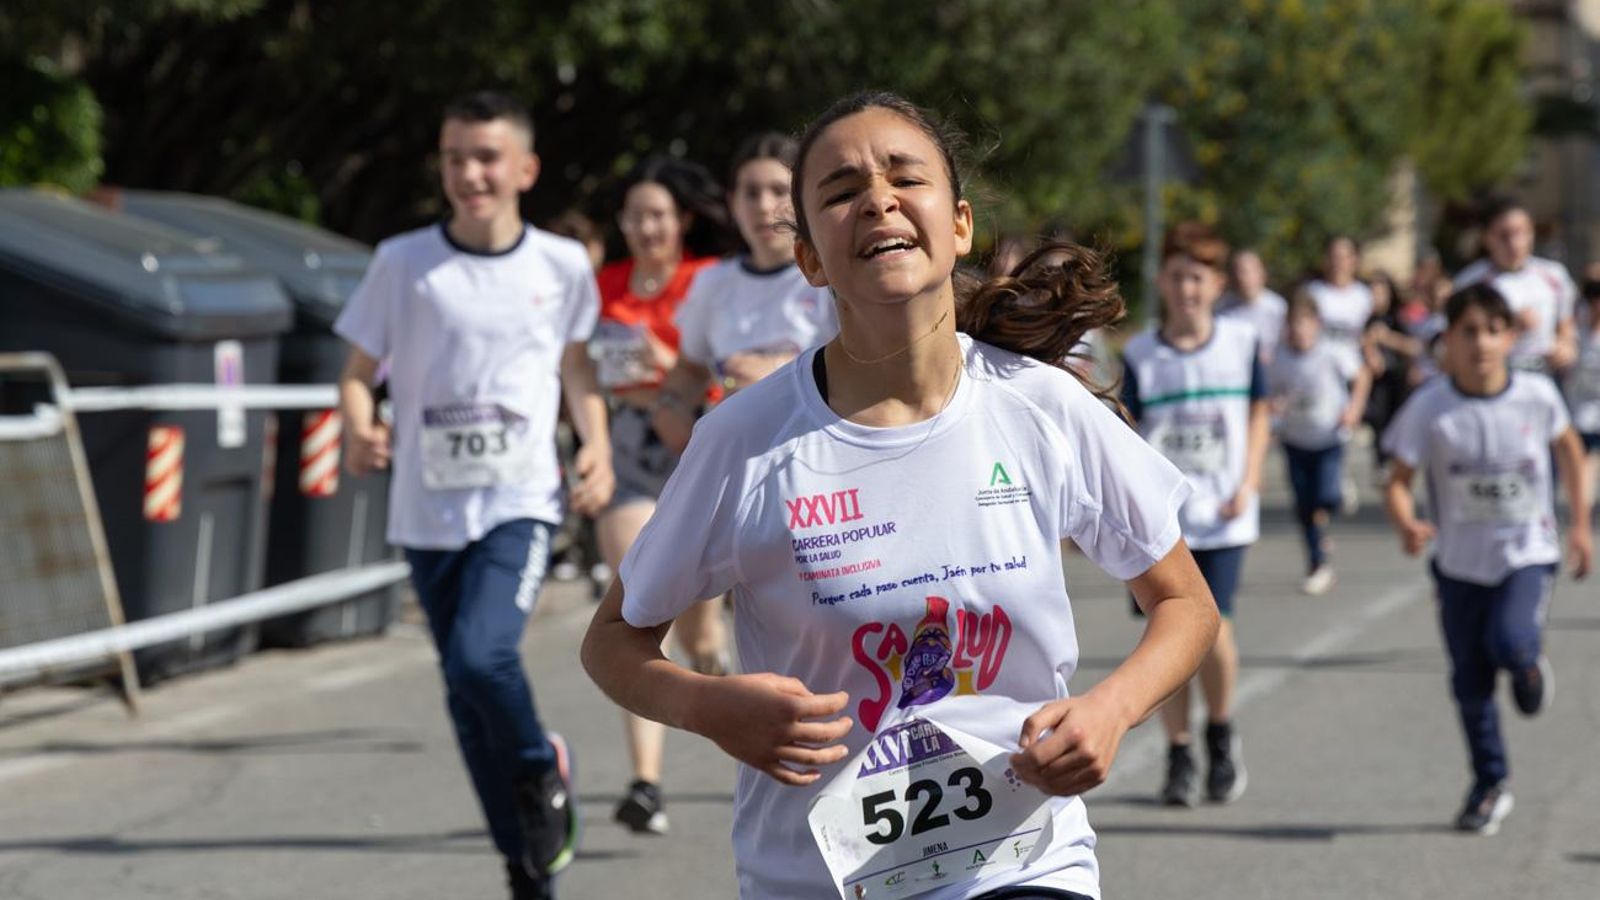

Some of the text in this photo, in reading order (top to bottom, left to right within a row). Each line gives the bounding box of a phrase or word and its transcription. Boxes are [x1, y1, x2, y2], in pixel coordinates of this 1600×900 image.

[446, 431, 508, 458] 703
[785, 488, 864, 530] XXVII
[792, 522, 897, 551] CARRERA POPULAR
[804, 568, 840, 581] CAMINATA
[842, 559, 881, 575] INCLUSIVA
[809, 553, 819, 563] LA
[819, 550, 842, 562] SALUD
[812, 555, 1027, 606] Porque cada paso cuenta, Jaén por tu salud
[922, 735, 941, 754] LA
[861, 766, 993, 845] 523
